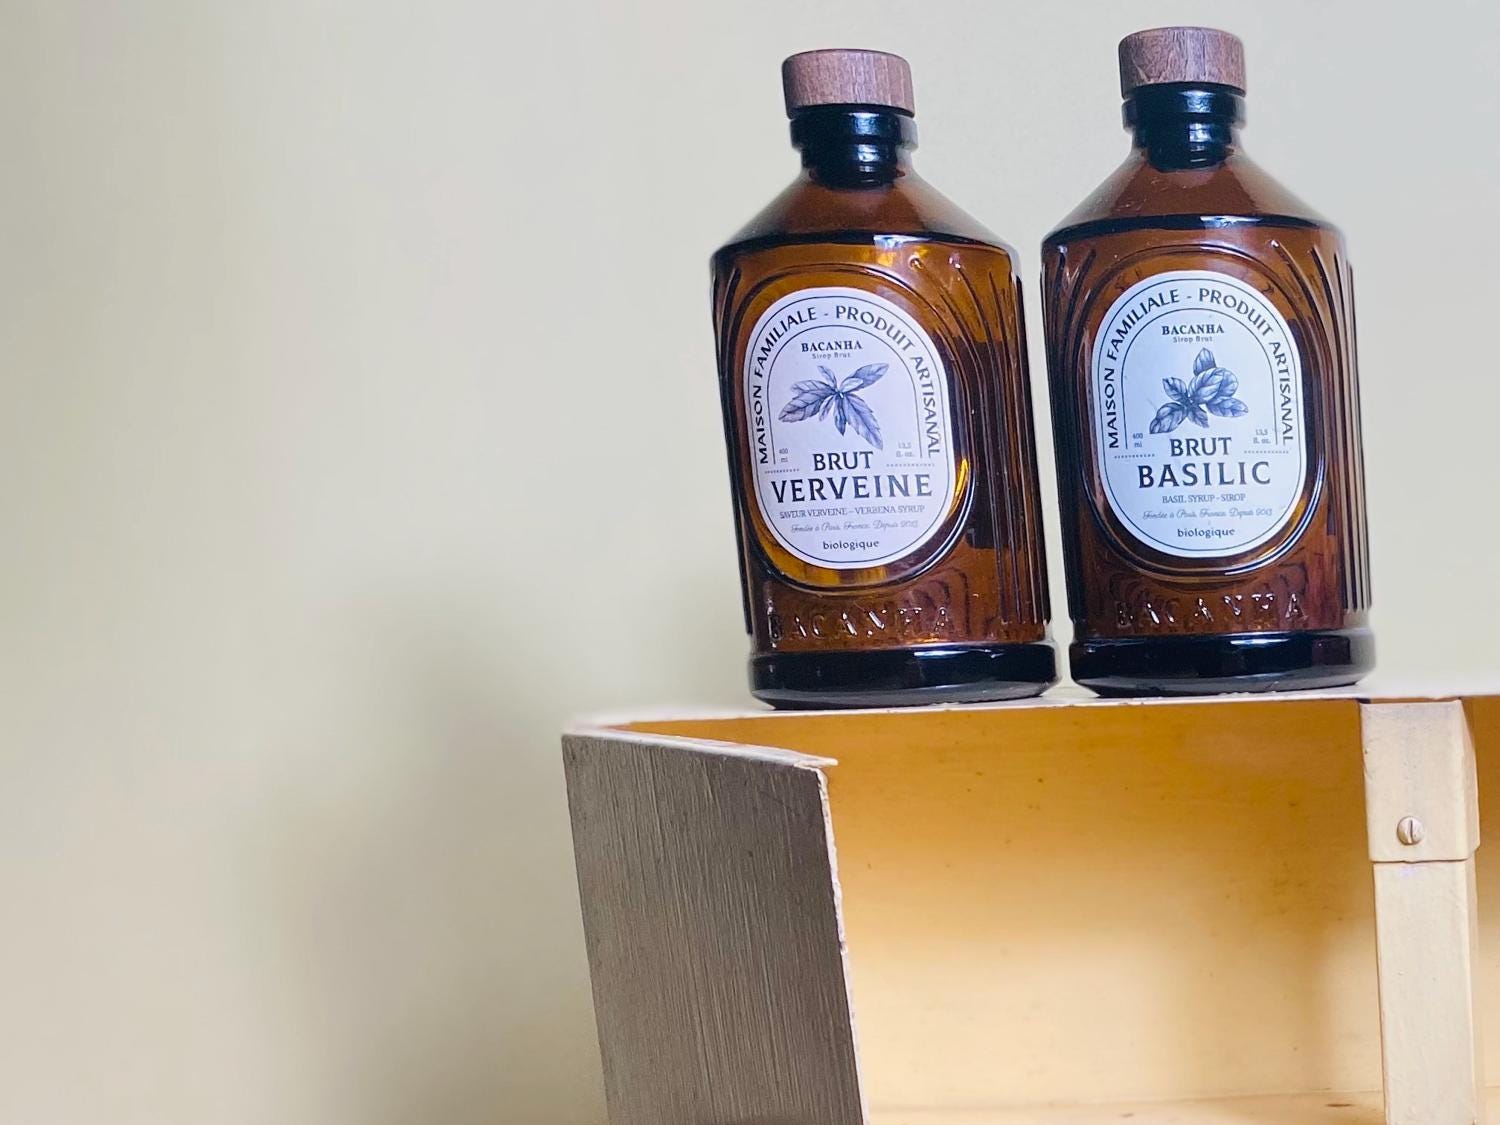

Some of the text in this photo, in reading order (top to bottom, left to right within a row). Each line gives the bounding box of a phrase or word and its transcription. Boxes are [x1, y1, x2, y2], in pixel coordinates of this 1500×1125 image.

[1199, 287, 1274, 337] PRODUIT
[836, 305, 915, 352] PRODUIT
[1107, 288, 1180, 361] FAMILIALE
[1161, 324, 1224, 335] BACANHA
[754, 306, 817, 379] FAMILIALE
[801, 340, 863, 353] BACANHA
[1172, 335, 1194, 344] Sirop
[811, 351, 832, 360] Sirop
[1269, 340, 1294, 446] ARTISANAL
[910, 355, 940, 459] ARTISANAL
[1104, 368, 1119, 449] MAISON
[753, 385, 769, 464] MAISON
[1170, 437, 1232, 457] BRUT
[812, 450, 874, 471] BRUT
[1138, 461, 1271, 489] BASILIC
[771, 474, 932, 503] VERVEINE
[1162, 495, 1186, 504] BASIL
[1188, 494, 1215, 503] SYRUP
[1220, 493, 1246, 502] SIROP
[780, 508, 806, 519] SAVEUR
[807, 507, 847, 518] VERVEINE
[854, 506, 896, 515] VERBENA
[898, 505, 925, 514] SYRUP
[1177, 528, 1236, 538] biologique
[823, 540, 880, 551] biologique
